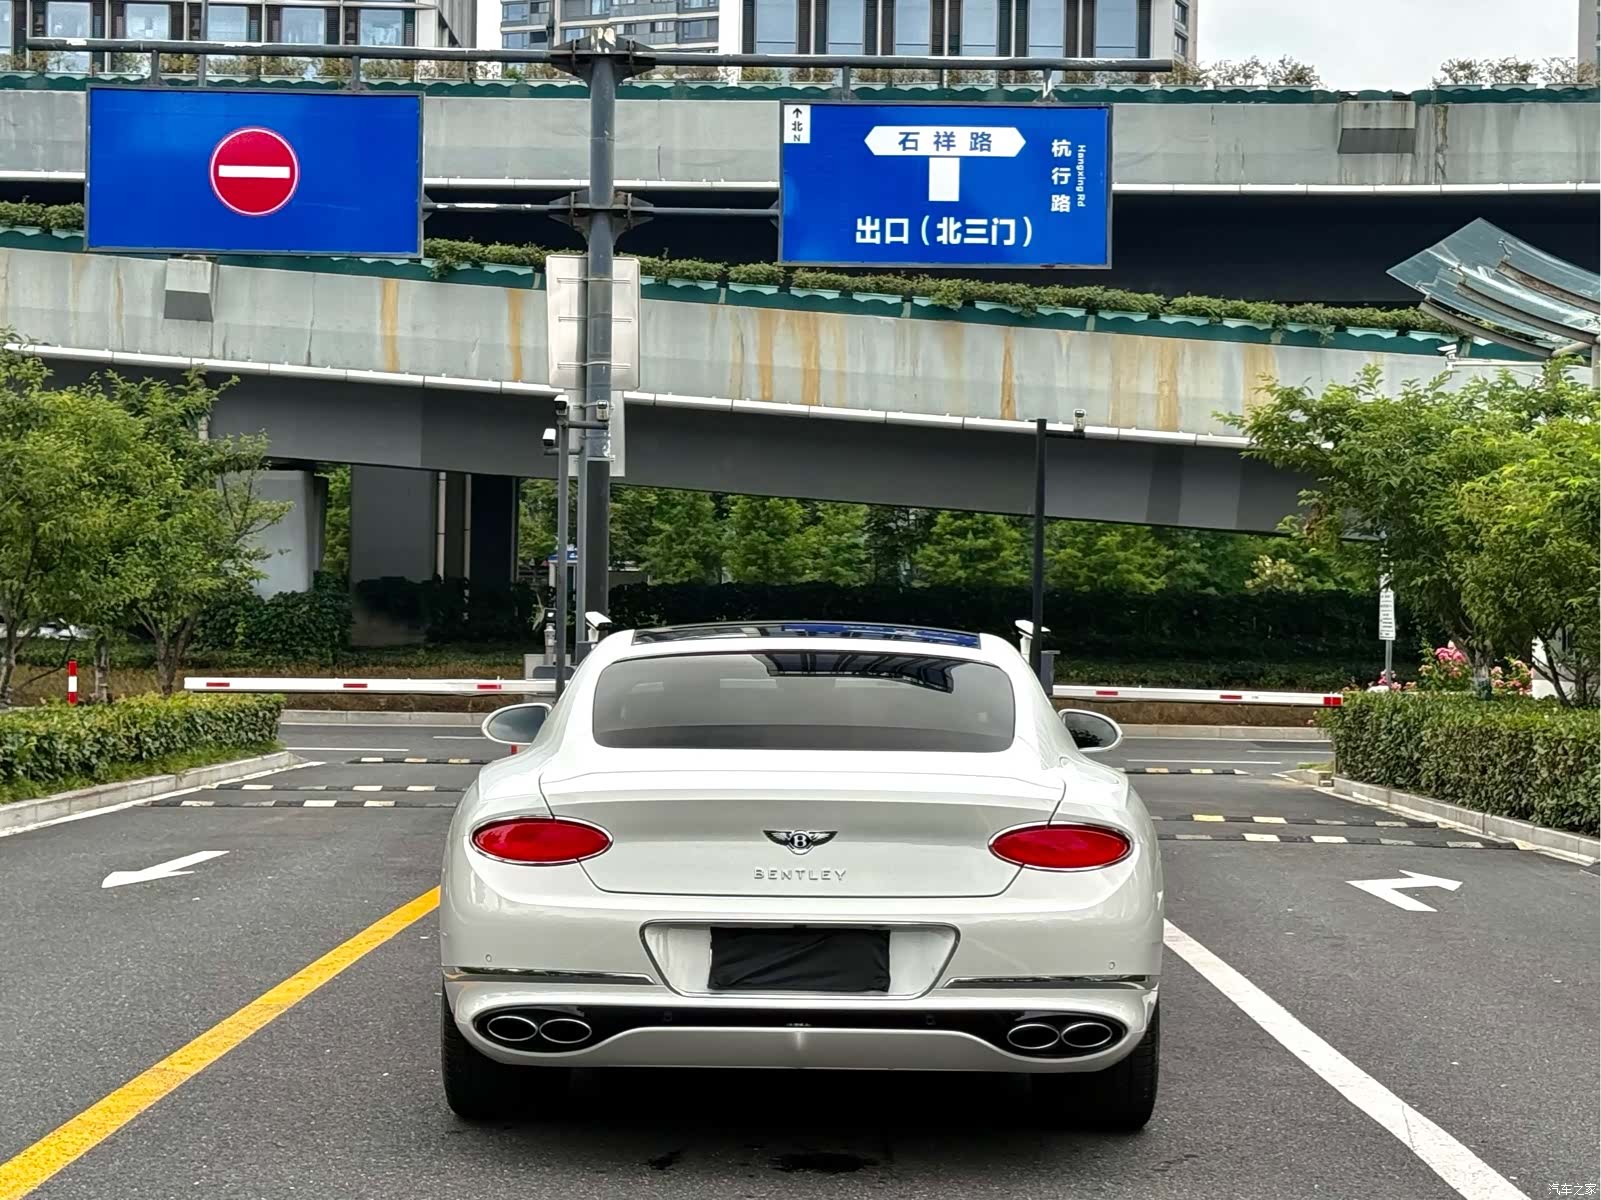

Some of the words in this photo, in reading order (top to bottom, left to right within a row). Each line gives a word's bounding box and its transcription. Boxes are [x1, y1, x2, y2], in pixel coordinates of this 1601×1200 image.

[791, 120, 803, 132] 北
[793, 134, 801, 142] N
[898, 130, 993, 153] 石祥路
[1050, 138, 1072, 213] 杭行路
[1075, 144, 1087, 193] Hangxing
[1077, 193, 1086, 208] Rd
[793, 835, 807, 849] B
[753, 867, 847, 881] BENTLEY
